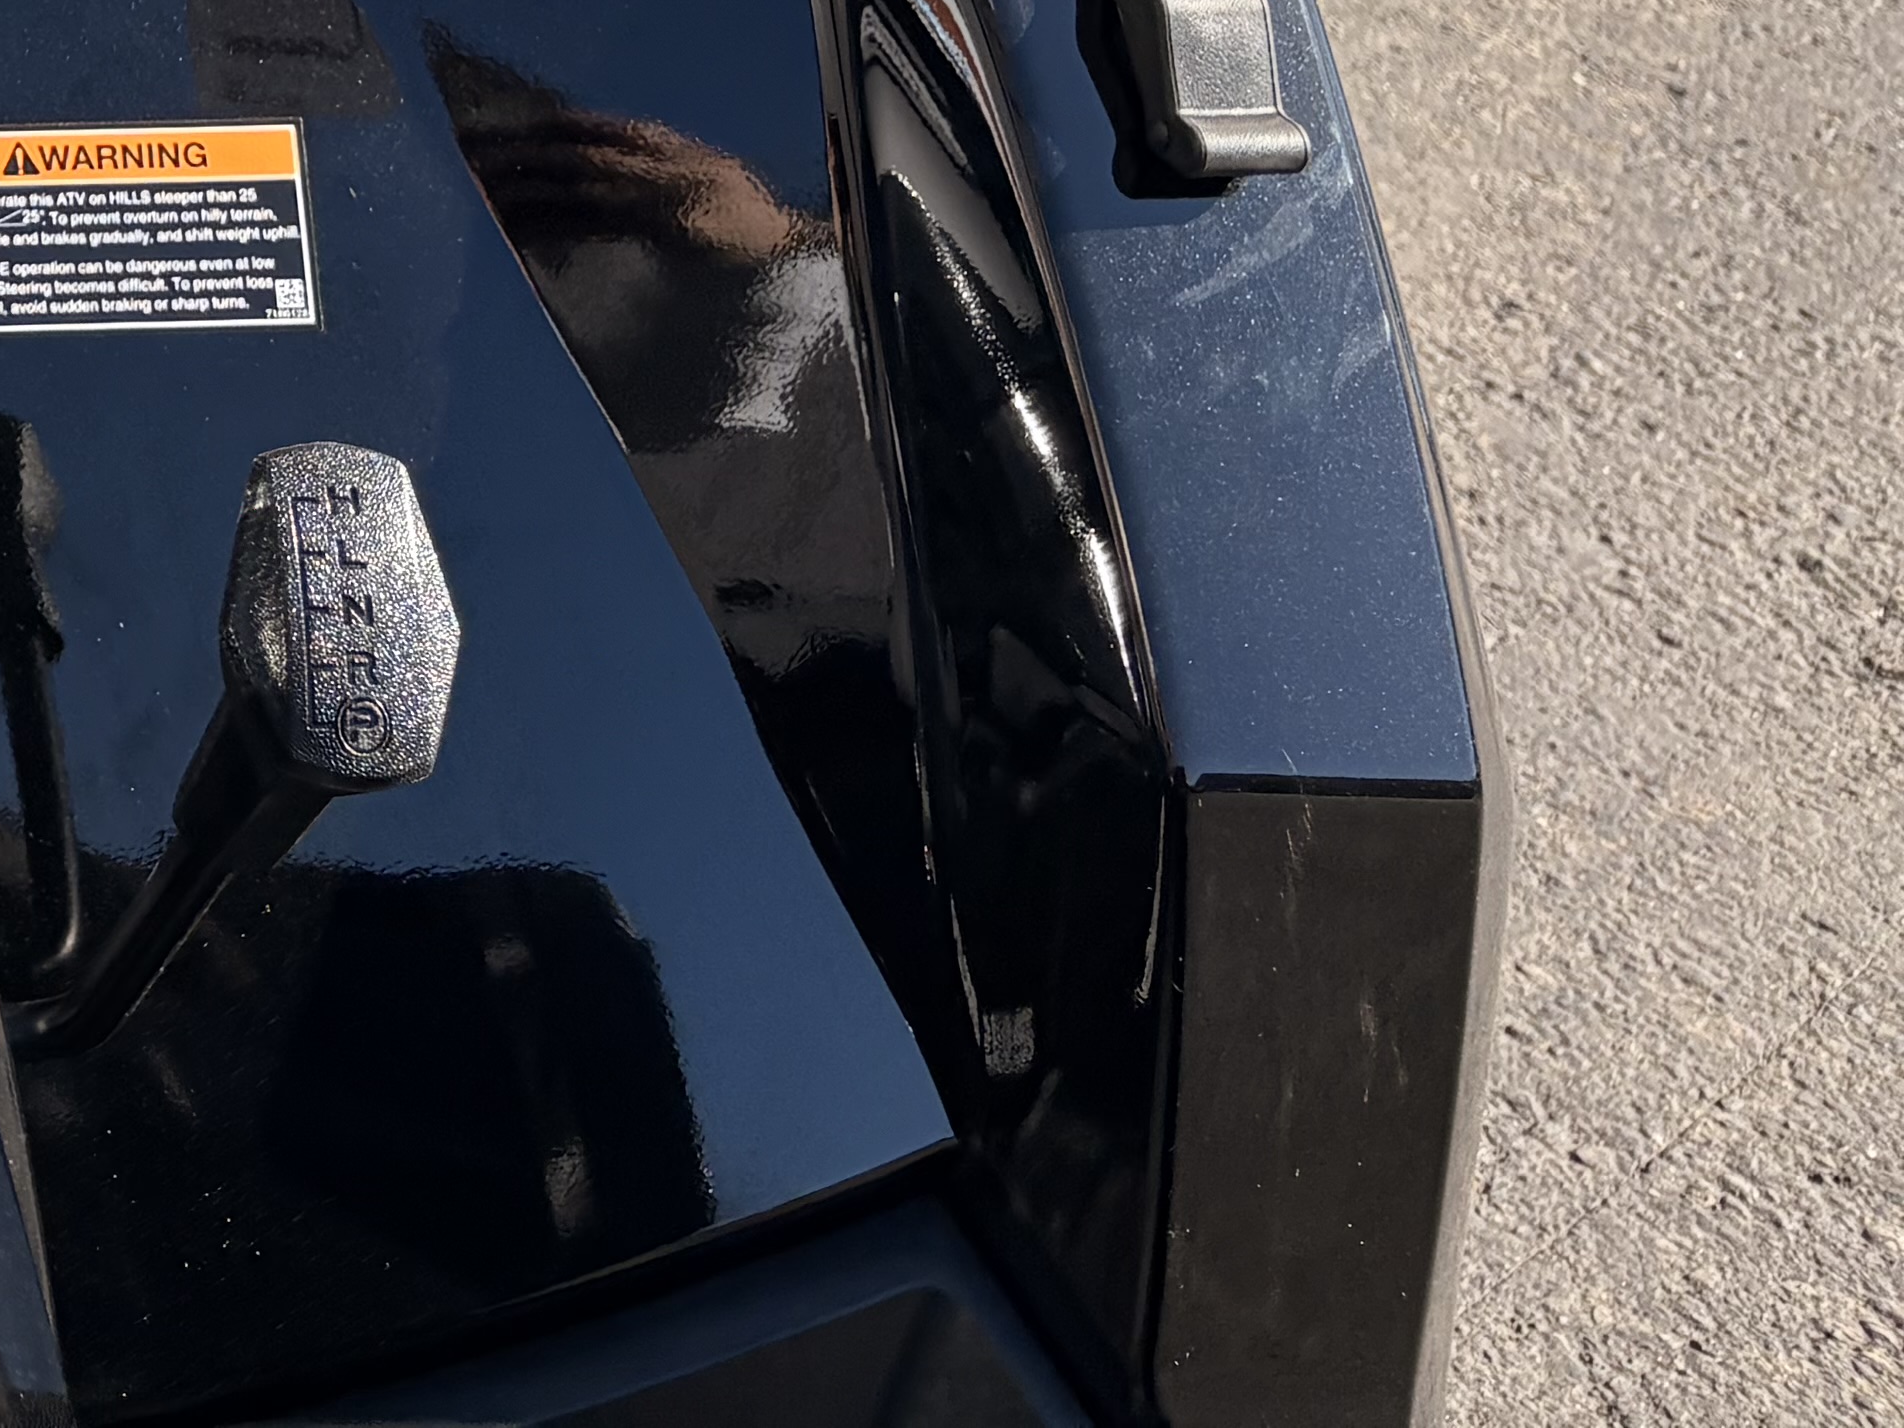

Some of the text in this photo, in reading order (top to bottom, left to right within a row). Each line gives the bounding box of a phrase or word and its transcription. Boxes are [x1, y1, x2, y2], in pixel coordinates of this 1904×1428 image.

[38, 141, 207, 171] WARNING
[12, 260, 75, 277] operation
[77, 261, 103, 274] can
[104, 259, 123, 273] be
[125, 259, 197, 275] dangerous
[198, 258, 233, 271] even
[235, 256, 249, 270] at
[251, 256, 275, 269] low
[338, 540, 368, 569] L
[342, 594, 375, 627] N
[346, 652, 377, 686] R
